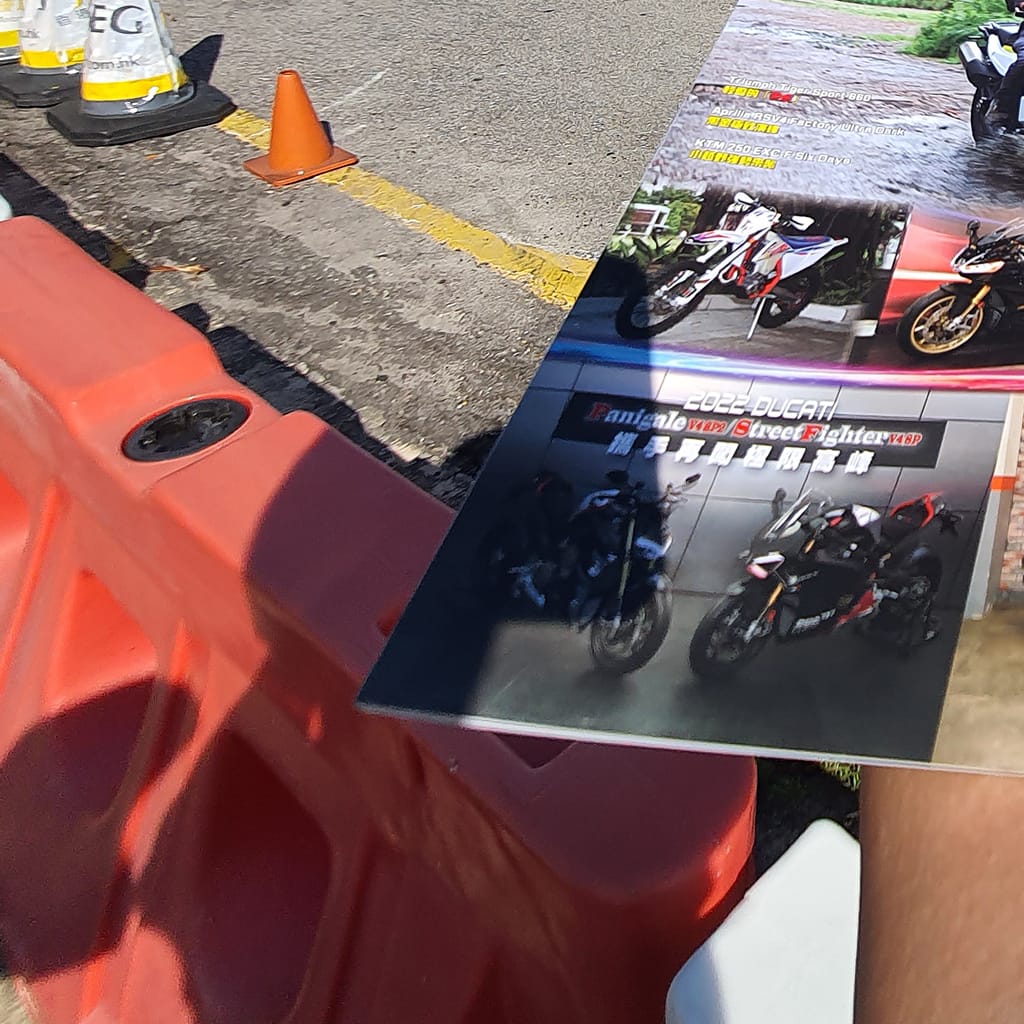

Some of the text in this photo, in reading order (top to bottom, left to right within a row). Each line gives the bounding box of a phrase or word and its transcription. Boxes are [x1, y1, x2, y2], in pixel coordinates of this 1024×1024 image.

[694, 137, 726, 151] KTM
[684, 392, 839, 422] 2022 DUCATI
